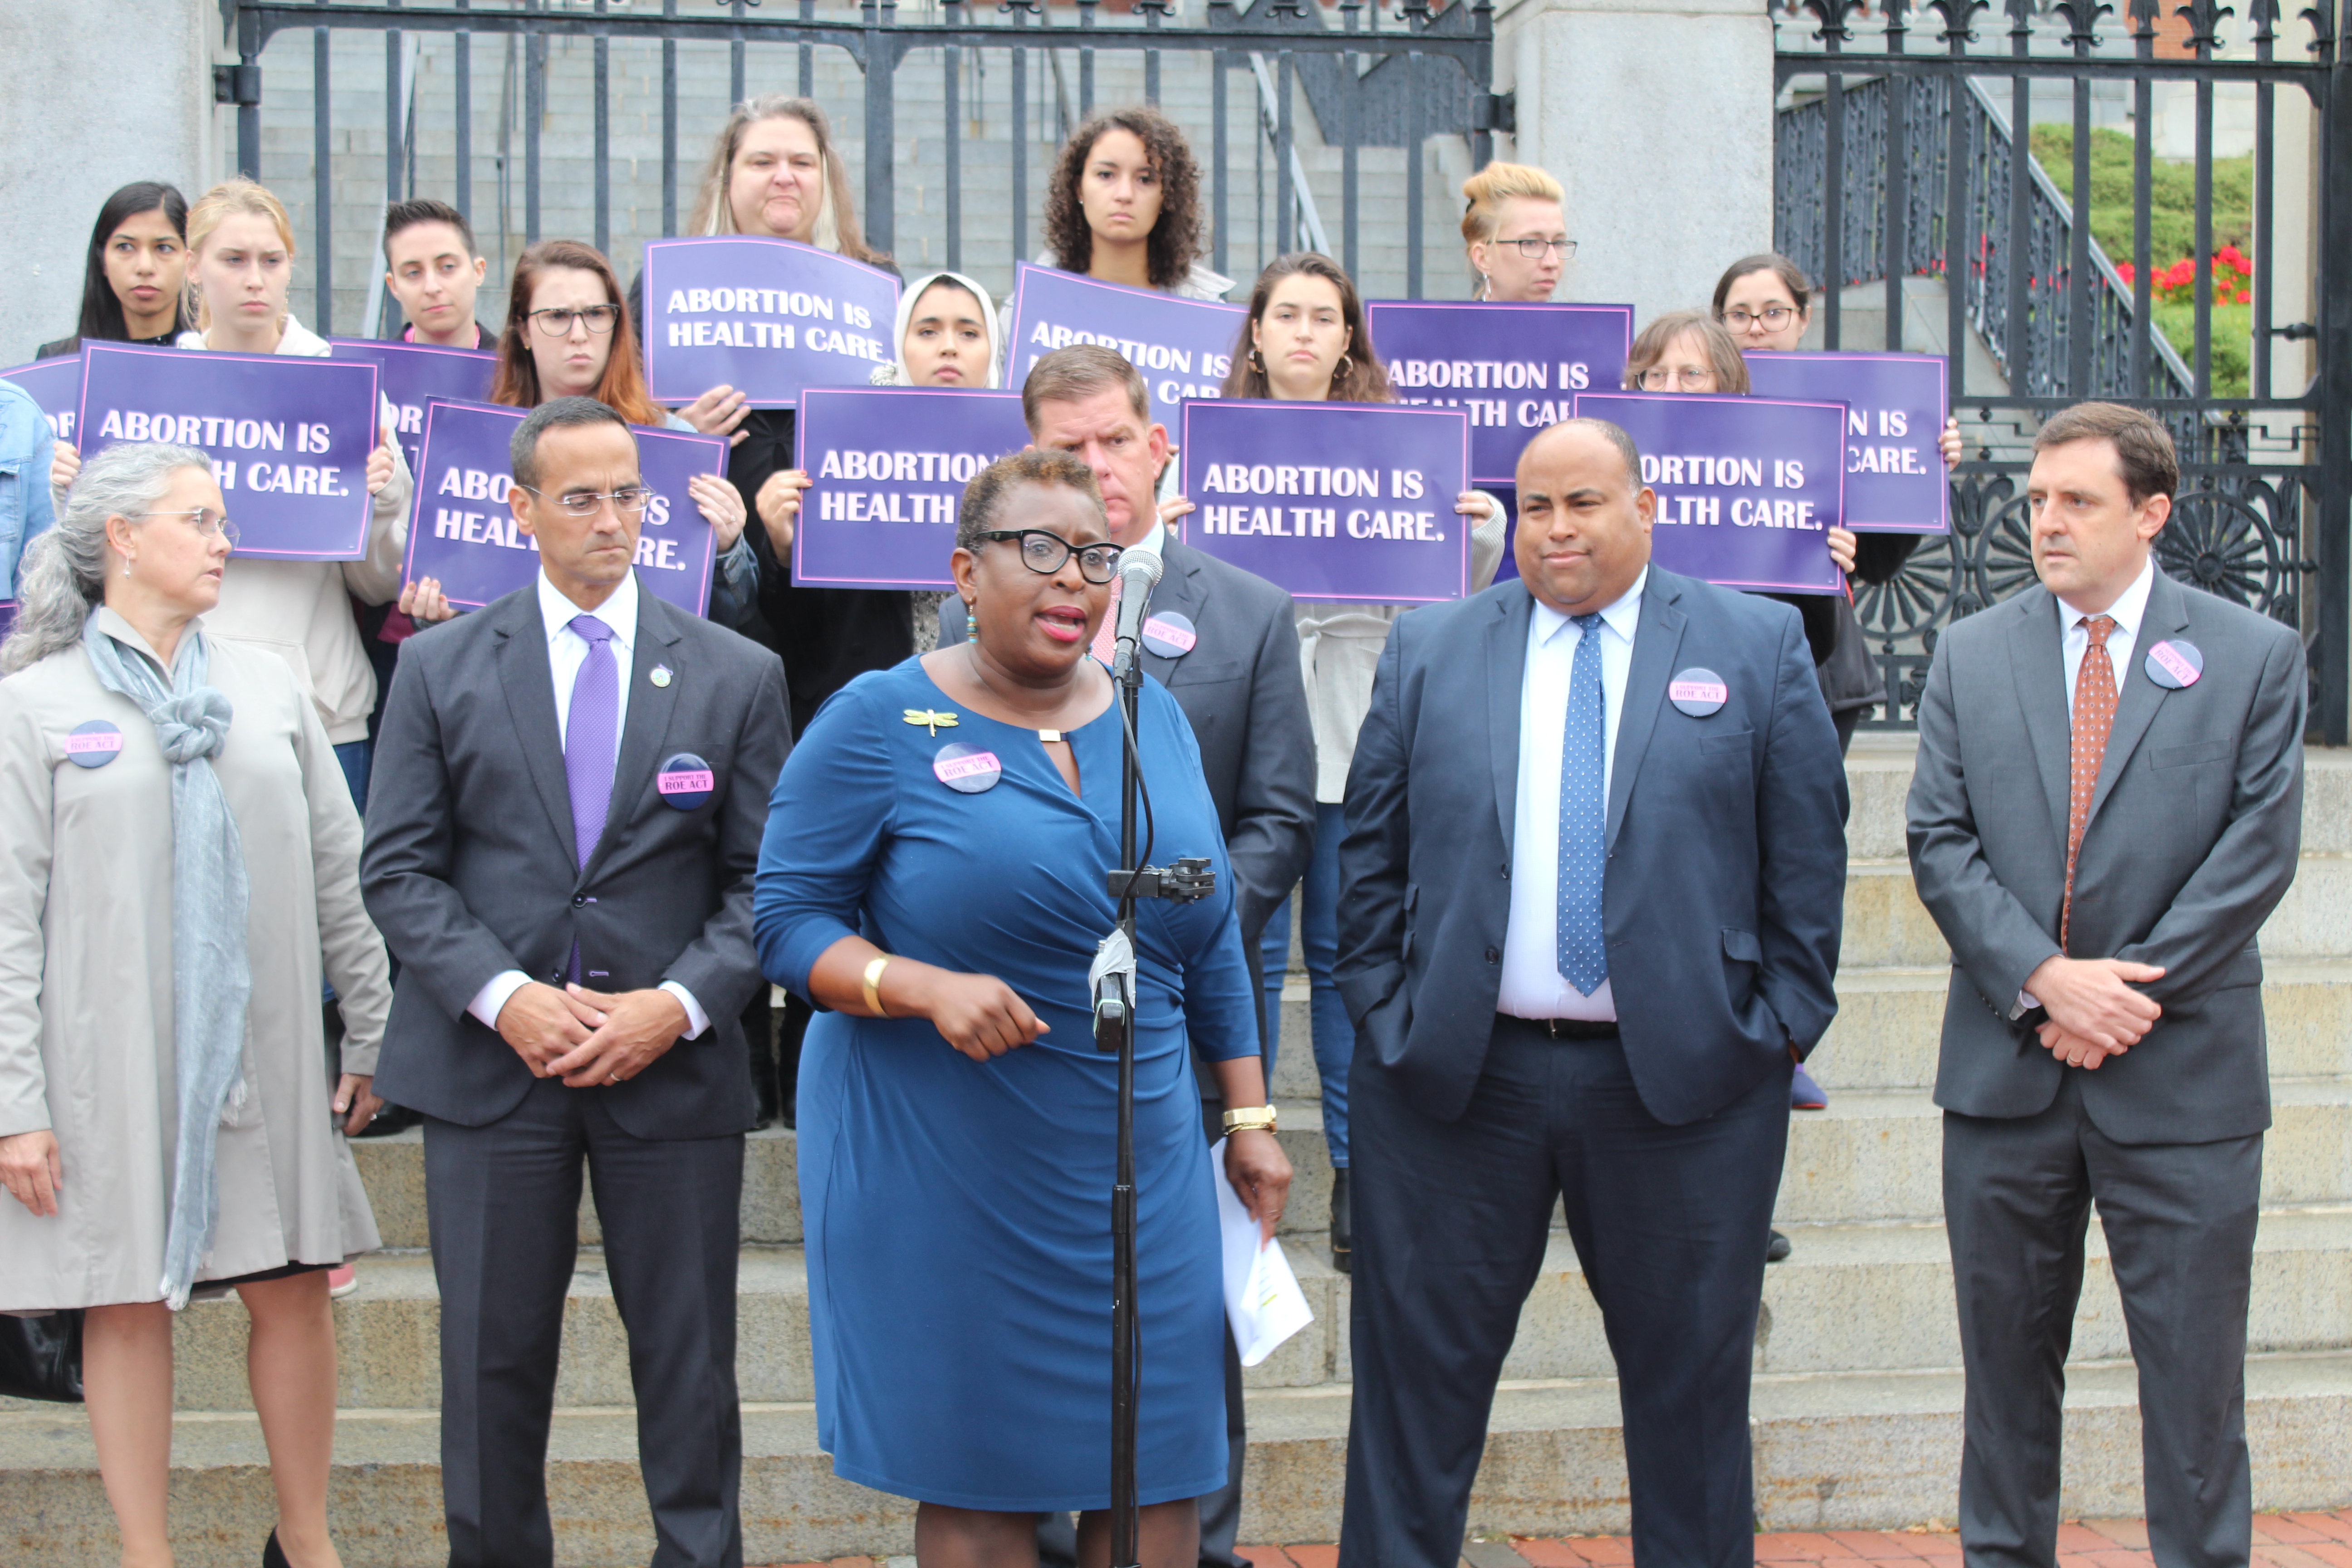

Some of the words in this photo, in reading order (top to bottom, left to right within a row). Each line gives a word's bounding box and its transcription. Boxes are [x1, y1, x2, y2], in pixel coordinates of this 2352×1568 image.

[667, 288, 833, 320] ABORTION
[843, 302, 872, 328] IS
[669, 322, 794, 348] HEALTH
[1202, 353, 1232, 378] IS
[1389, 360, 1547, 389] ABORTION
[1559, 363, 1589, 390] IS
[100, 410, 285, 451] ABORTION
[298, 422, 330, 453] IS
[1880, 411, 1907, 436] IS
[247, 462, 349, 496] CARE.
[1203, 465, 1378, 497] ABORTION
[1392, 470, 1424, 499] IS
[1641, 456, 1761, 486] ORTION
[1775, 460, 1804, 489] IS
[821, 492, 954, 523] HEALTH
[1731, 499, 1823, 530] CARE.
[1204, 505, 1335, 537] HEALTH
[1348, 510, 1445, 541] CARE.
[632, 537, 686, 571] RE.
[1147, 626, 1168, 639] ROE
[1169, 635, 1189, 646] ACT
[2155, 650, 2173, 666] ROE
[2171, 666, 2191, 680] ACT
[1676, 690, 1697, 698] ROE
[1700, 691, 1721, 700] ACT
[71, 742, 92, 750] ROE
[944, 765, 970, 777] ROE
[972, 760, 994, 771] ACT
[946, 758, 975, 768] SUPPORT
[665, 781, 686, 790] ROE
[690, 780, 708, 789] ACT
